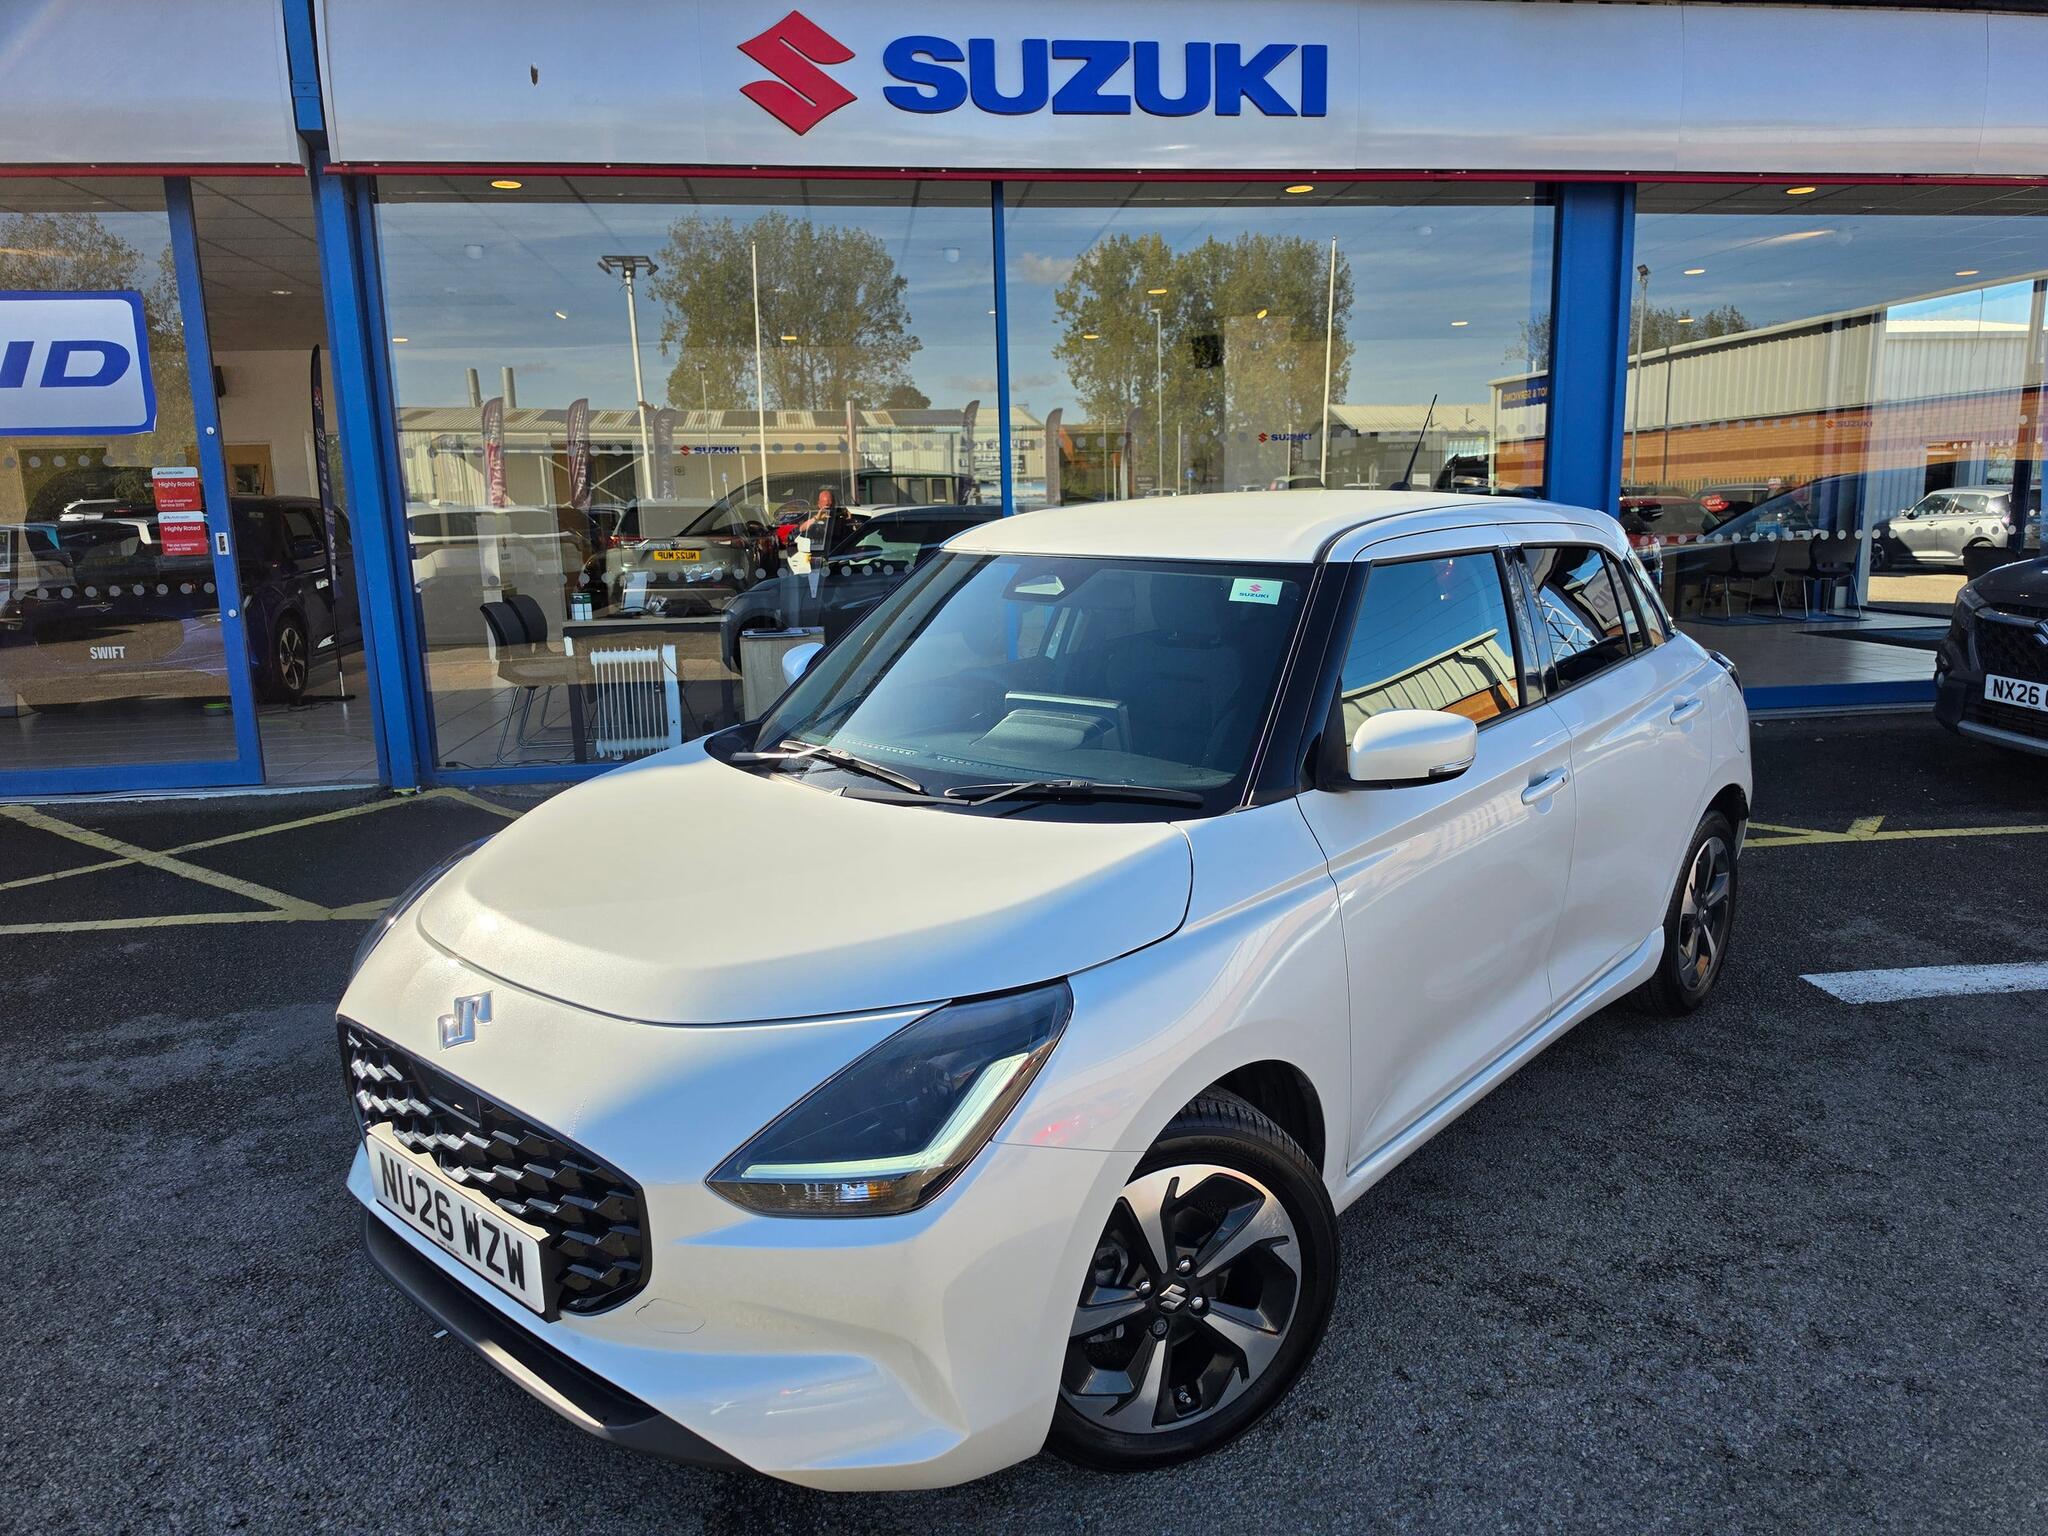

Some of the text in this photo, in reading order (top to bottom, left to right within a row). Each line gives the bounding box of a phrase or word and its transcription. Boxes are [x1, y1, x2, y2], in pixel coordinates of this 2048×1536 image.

[883, 35, 1328, 118] SUZUKI
[1271, 433, 1312, 441] SUZUKI
[694, 446, 740, 455] SUZUKI
[159, 481, 177, 489] Highly
[165, 525, 183, 533] Highly
[90, 646, 125, 660] SWIFT
[1993, 679, 2040, 705] NX26
[380, 1152, 525, 1291] NU26 WZW
